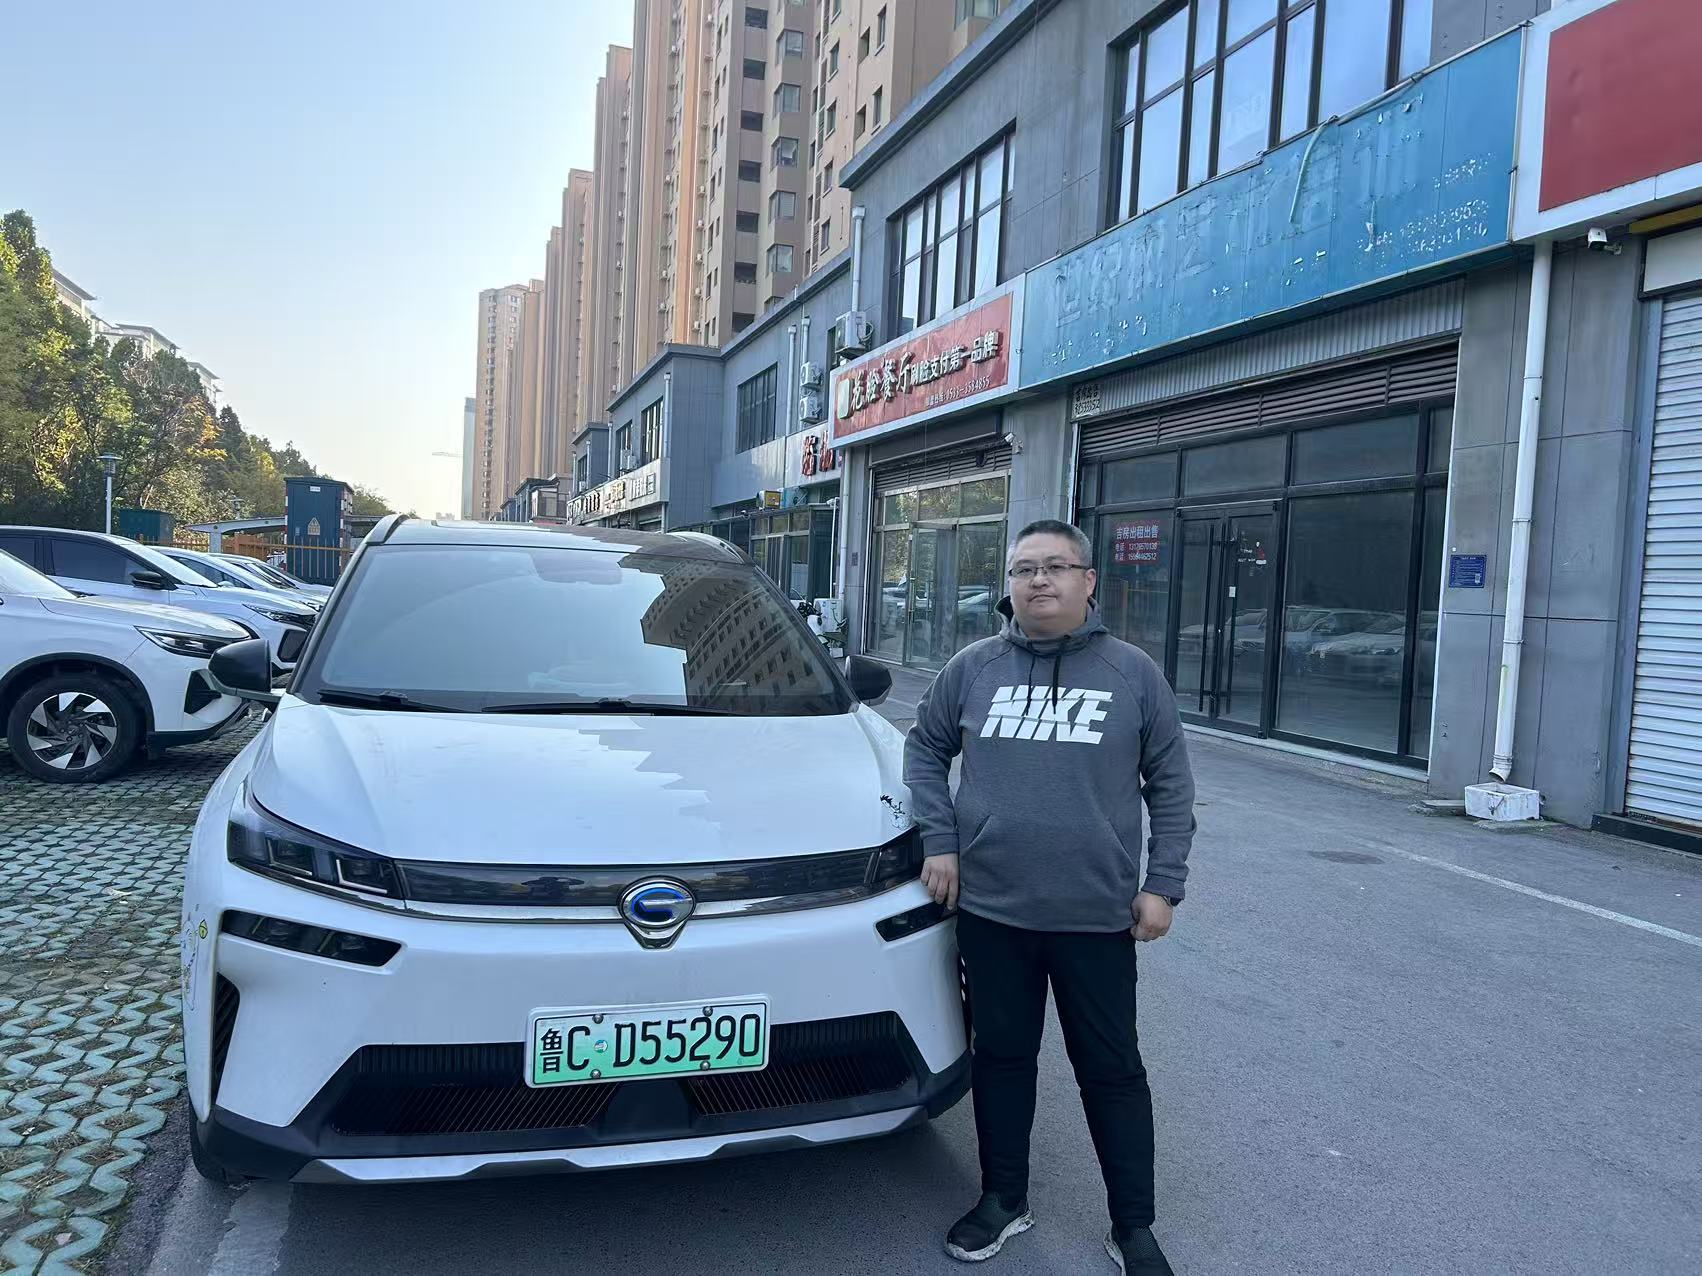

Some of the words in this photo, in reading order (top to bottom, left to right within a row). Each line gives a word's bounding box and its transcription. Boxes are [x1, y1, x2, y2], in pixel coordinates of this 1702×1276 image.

[1116, 525, 1159, 540] 吉房出租出售
[979, 684, 1113, 745] NIKE
